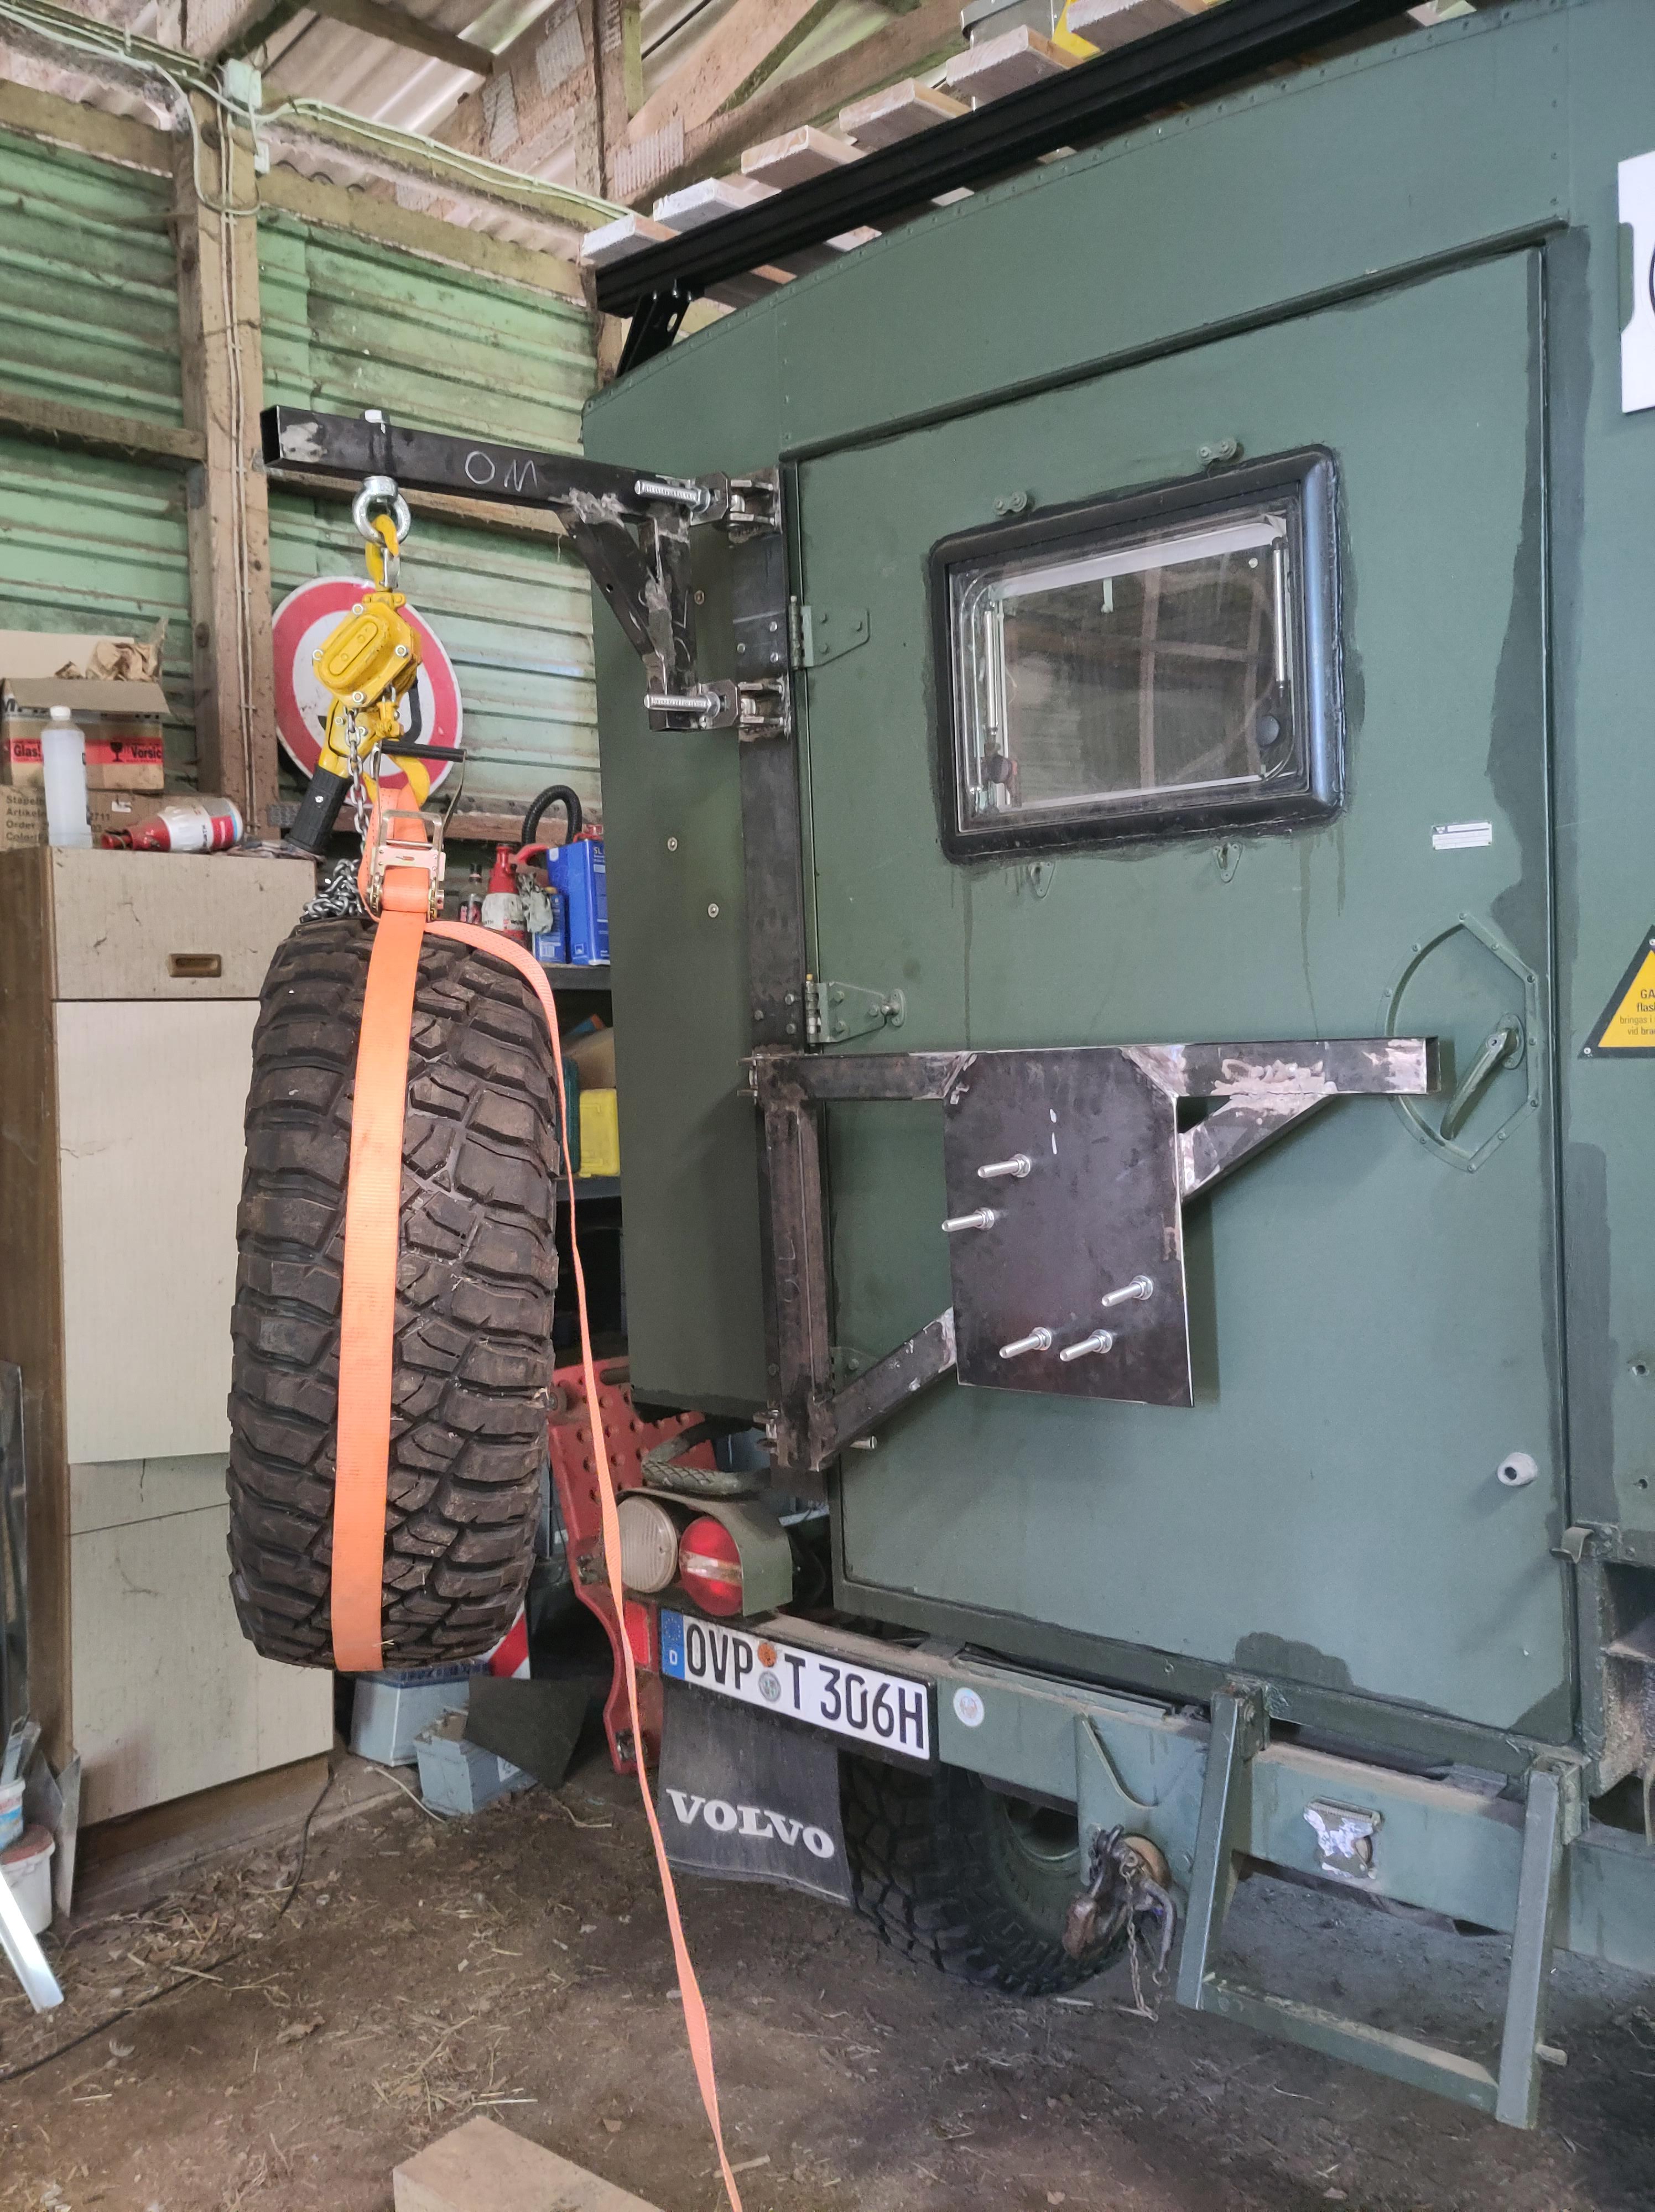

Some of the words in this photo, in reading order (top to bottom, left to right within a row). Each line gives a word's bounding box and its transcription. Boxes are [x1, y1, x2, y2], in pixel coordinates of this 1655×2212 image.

[14, 744, 41, 758] Glas!
[1620, 1015, 1647, 1025] bringas
[1627, 1026, 1638, 1035] vid
[686, 1623, 753, 1690] OVP
[819, 1663, 924, 1750] 306H
[665, 1788, 835, 1859] VOLVO
